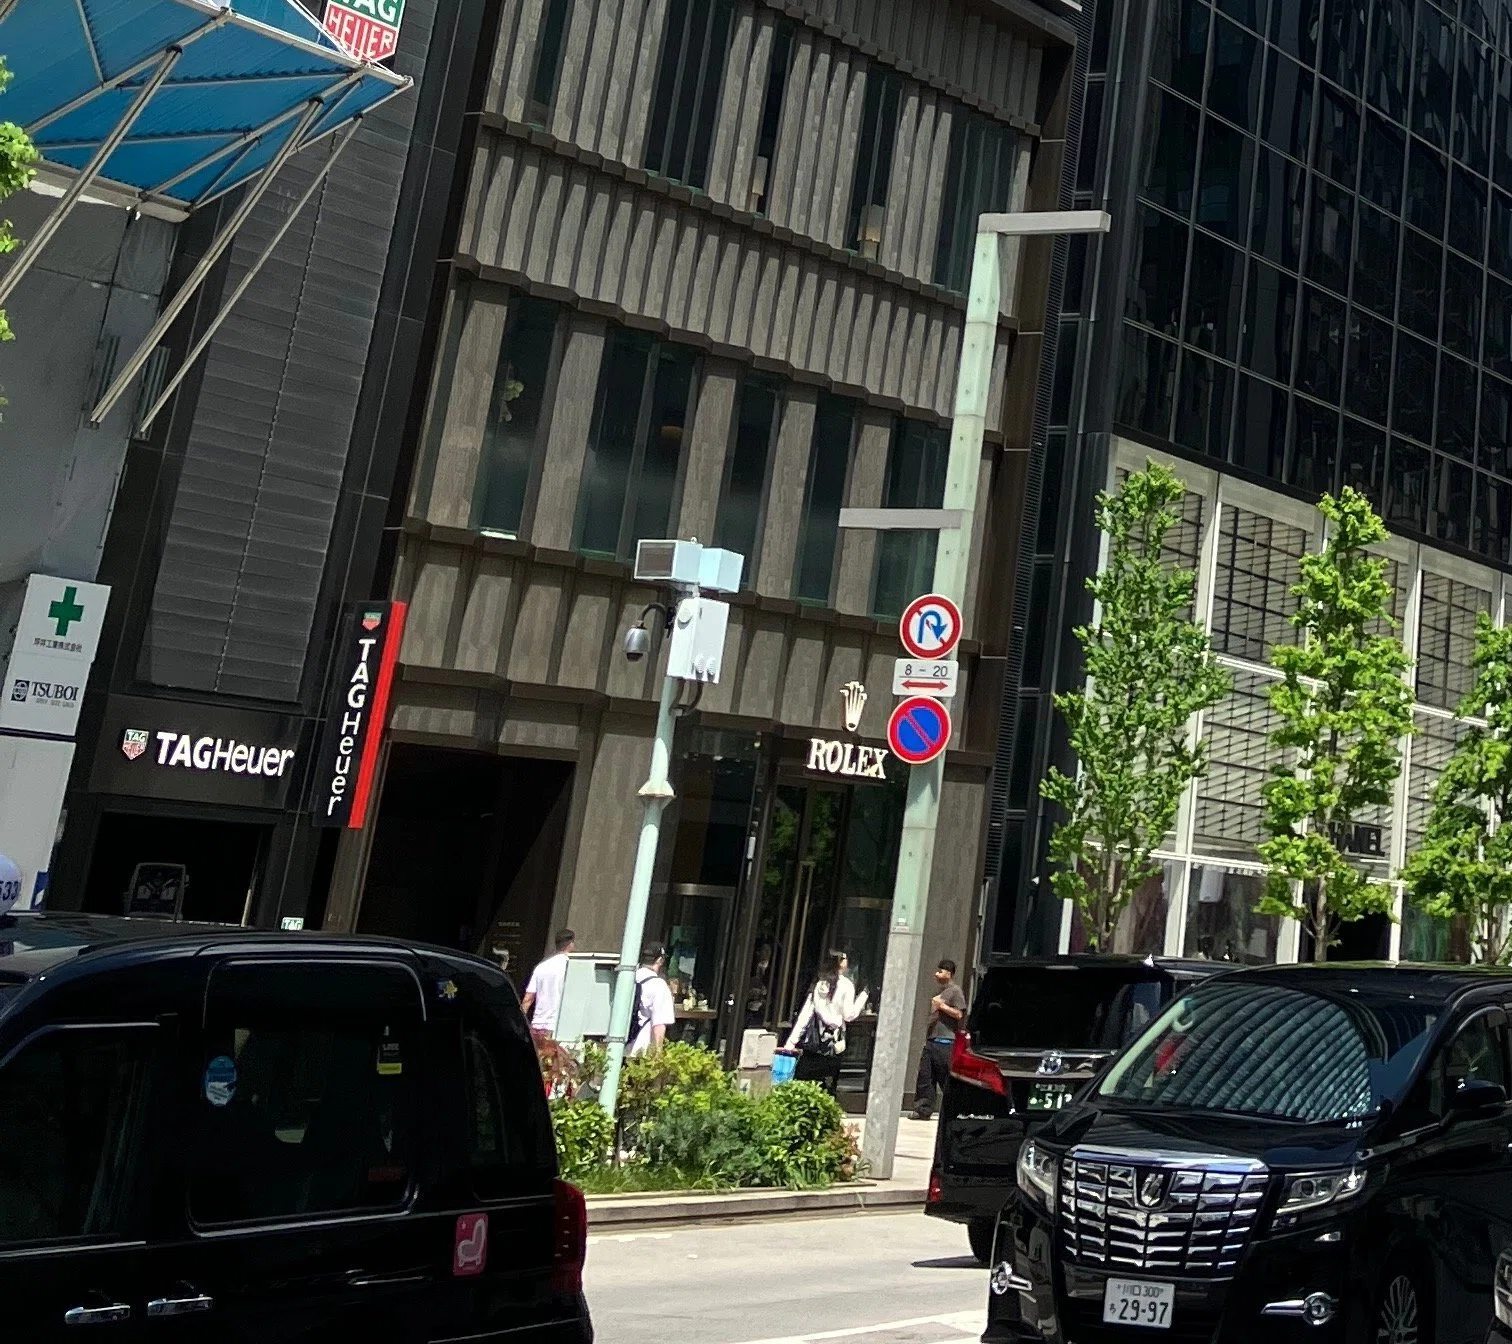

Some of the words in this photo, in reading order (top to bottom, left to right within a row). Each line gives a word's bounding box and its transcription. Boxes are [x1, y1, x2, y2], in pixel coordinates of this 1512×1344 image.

[328, 7, 395, 61] HEUER
[904, 663, 913, 677] 8
[932, 665, 949, 678] 20
[31, 681, 79, 701] TSUBOI
[127, 732, 146, 743] TAG
[807, 738, 889, 781] ROLEX
[1143, 1285, 1161, 1298] 300
[1118, 1298, 1169, 1325] 29-97
